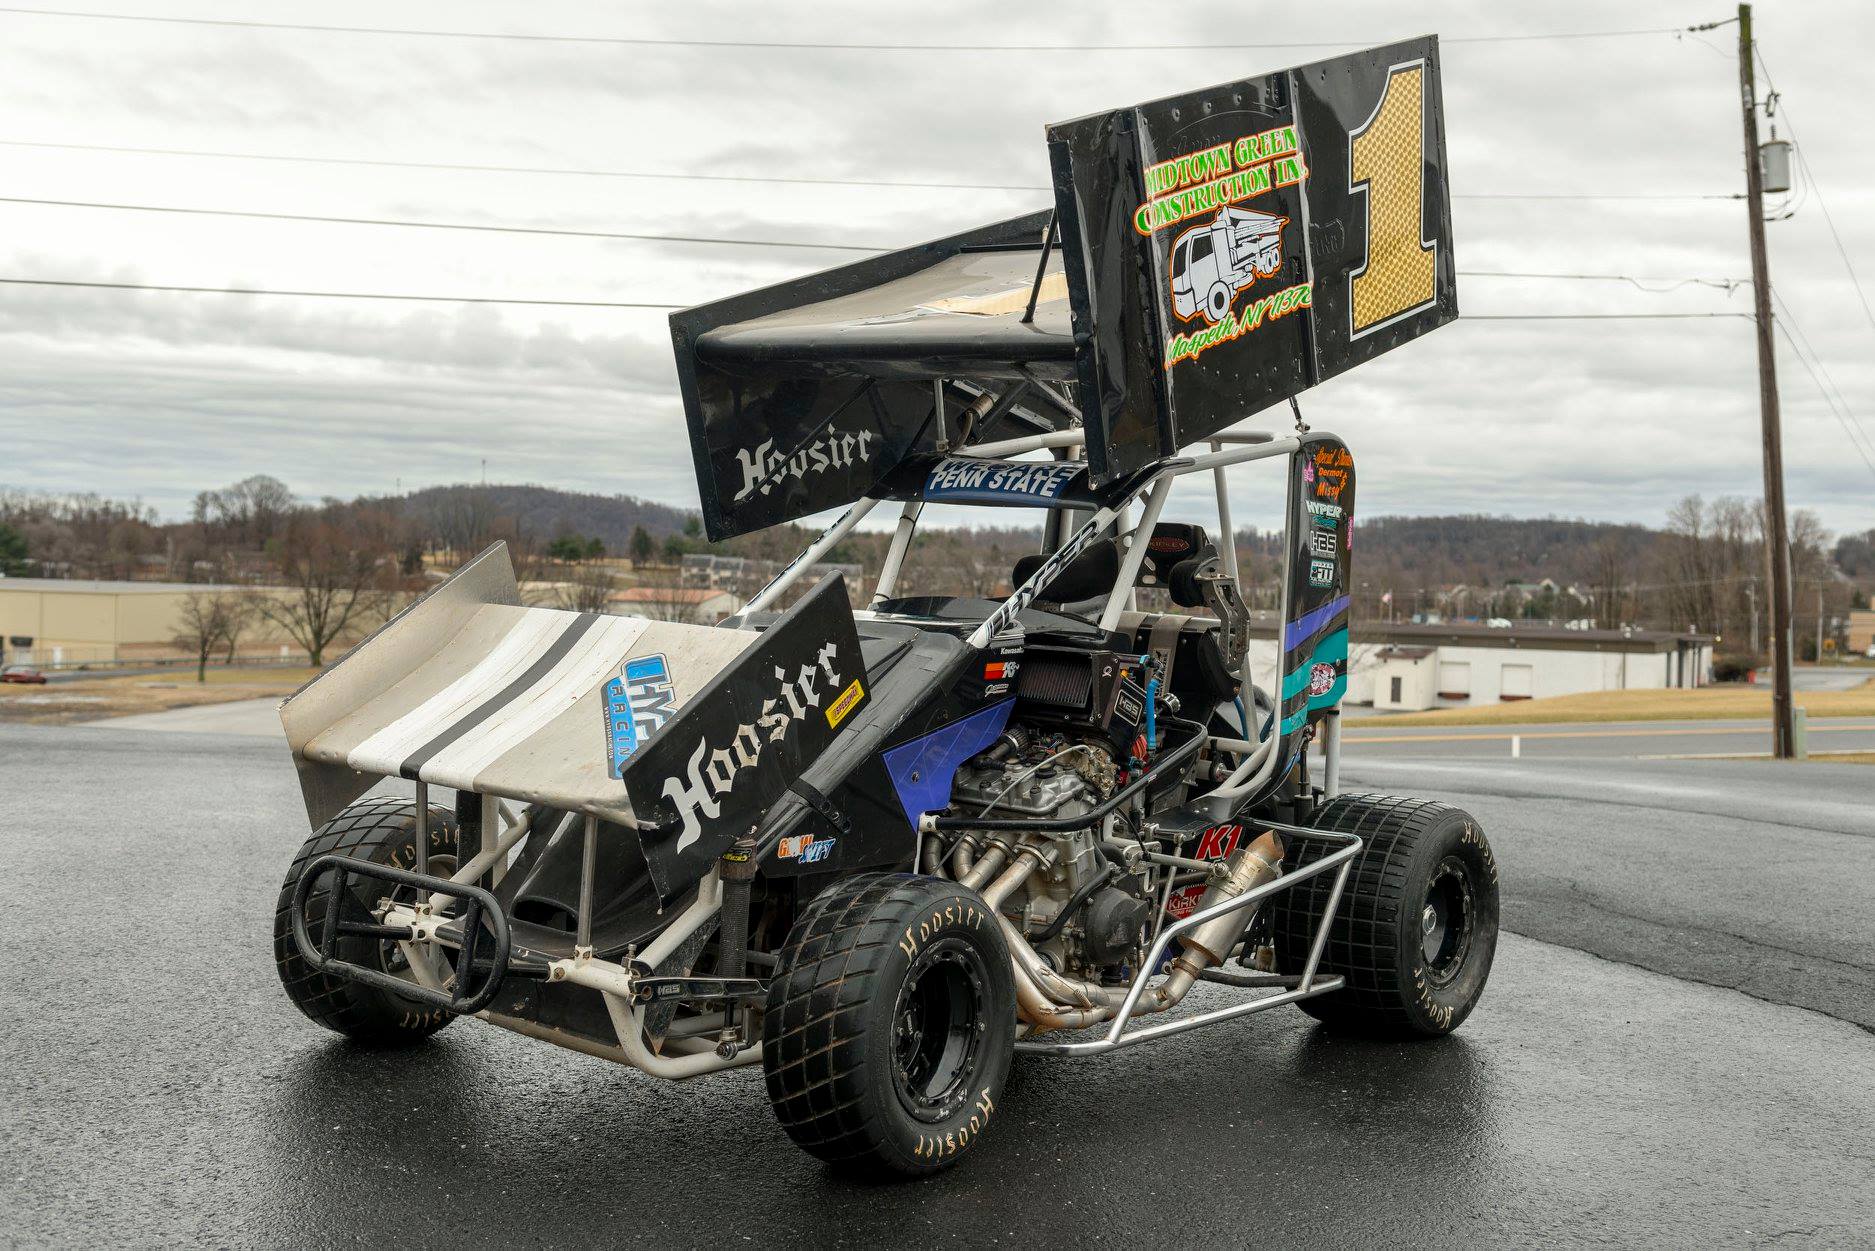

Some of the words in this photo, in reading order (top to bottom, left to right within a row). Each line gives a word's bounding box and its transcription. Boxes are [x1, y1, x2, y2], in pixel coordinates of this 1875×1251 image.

[1234, 125, 1297, 168] GREEN
[1134, 163, 1272, 235] CONSTRUCTION
[1349, 58, 1438, 342] 1
[733, 423, 873, 502] Hoosier
[929, 467, 990, 490] PENN
[988, 470, 1063, 498] STATE
[1306, 499, 1343, 518] HYPER
[661, 642, 840, 855] Hoosier
[1195, 824, 1244, 861] K1
[900, 896, 985, 963] Hoosier
[914, 1086, 994, 1162] Hoosier
